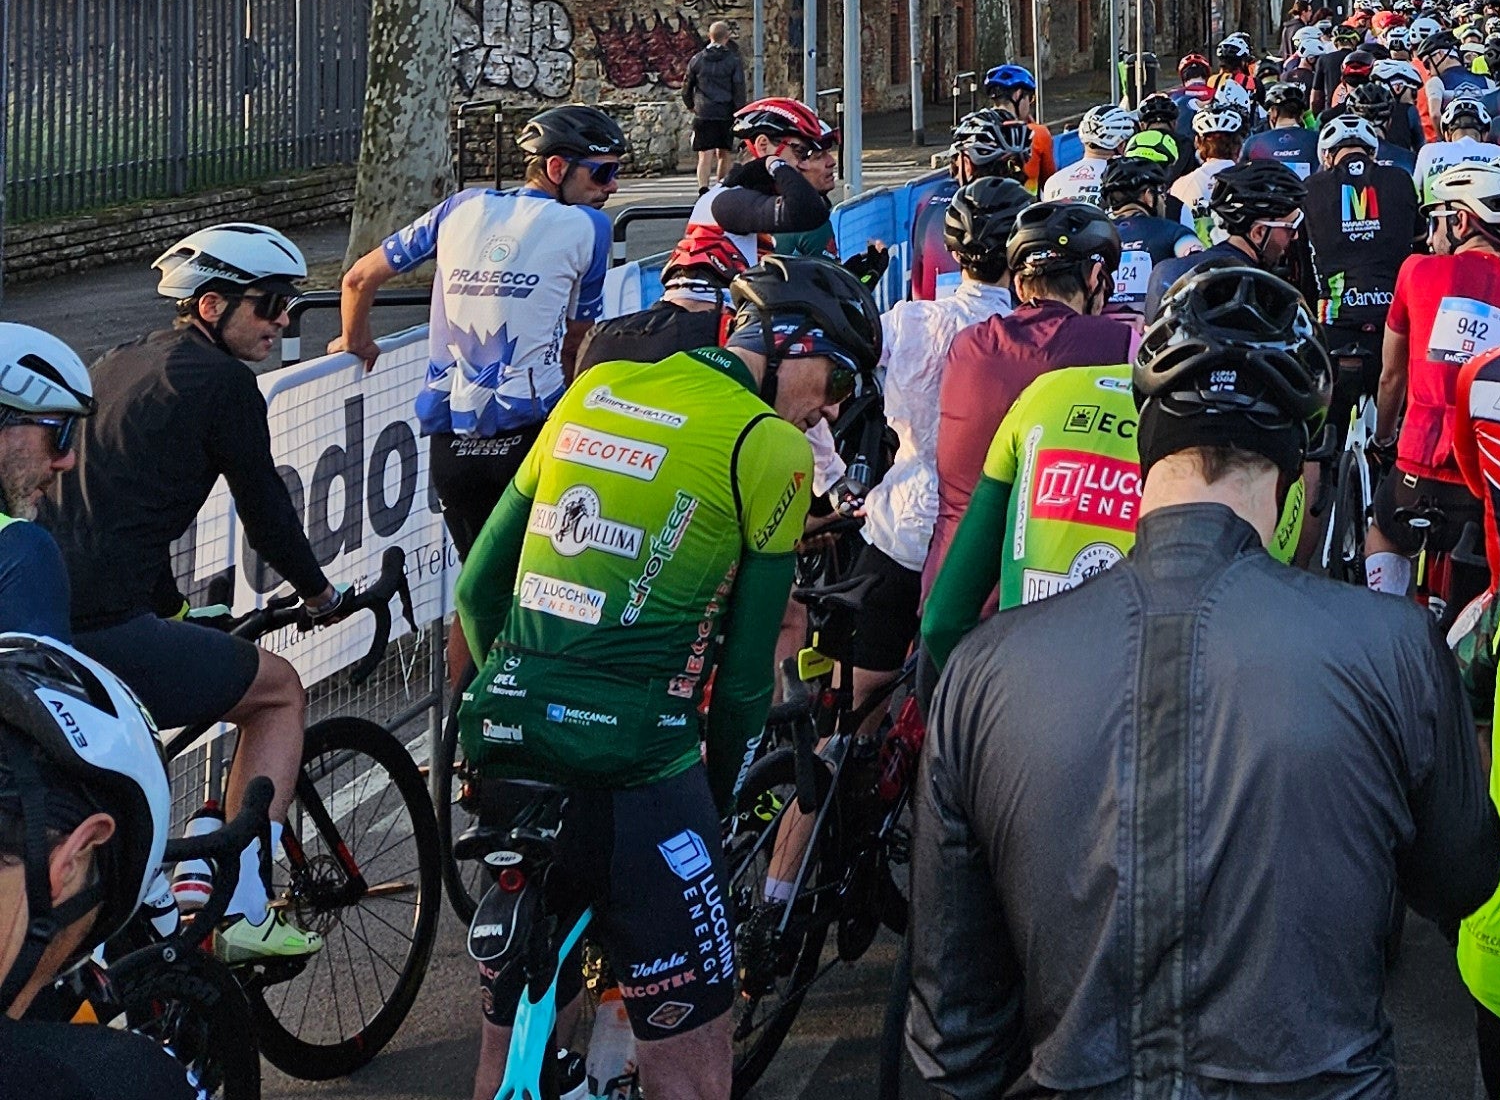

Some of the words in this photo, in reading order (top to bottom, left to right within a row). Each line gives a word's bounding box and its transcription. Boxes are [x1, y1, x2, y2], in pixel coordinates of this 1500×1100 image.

[449, 268, 541, 286] PRASECCO
[1347, 287, 1395, 307] Carvico
[1456, 317, 1489, 341] 942
[576, 437, 659, 471] ECOTEK
[1078, 493, 1133, 520] ENE
[573, 513, 636, 552] GALLINA
[543, 581, 601, 608] LUCCHINI
[537, 597, 600, 619] ENERGY
[493, 673, 518, 687] OPEL
[565, 708, 618, 726] MECCANICA
[683, 885, 720, 987] ENERGY
[700, 873, 735, 980] LUCCHINI
